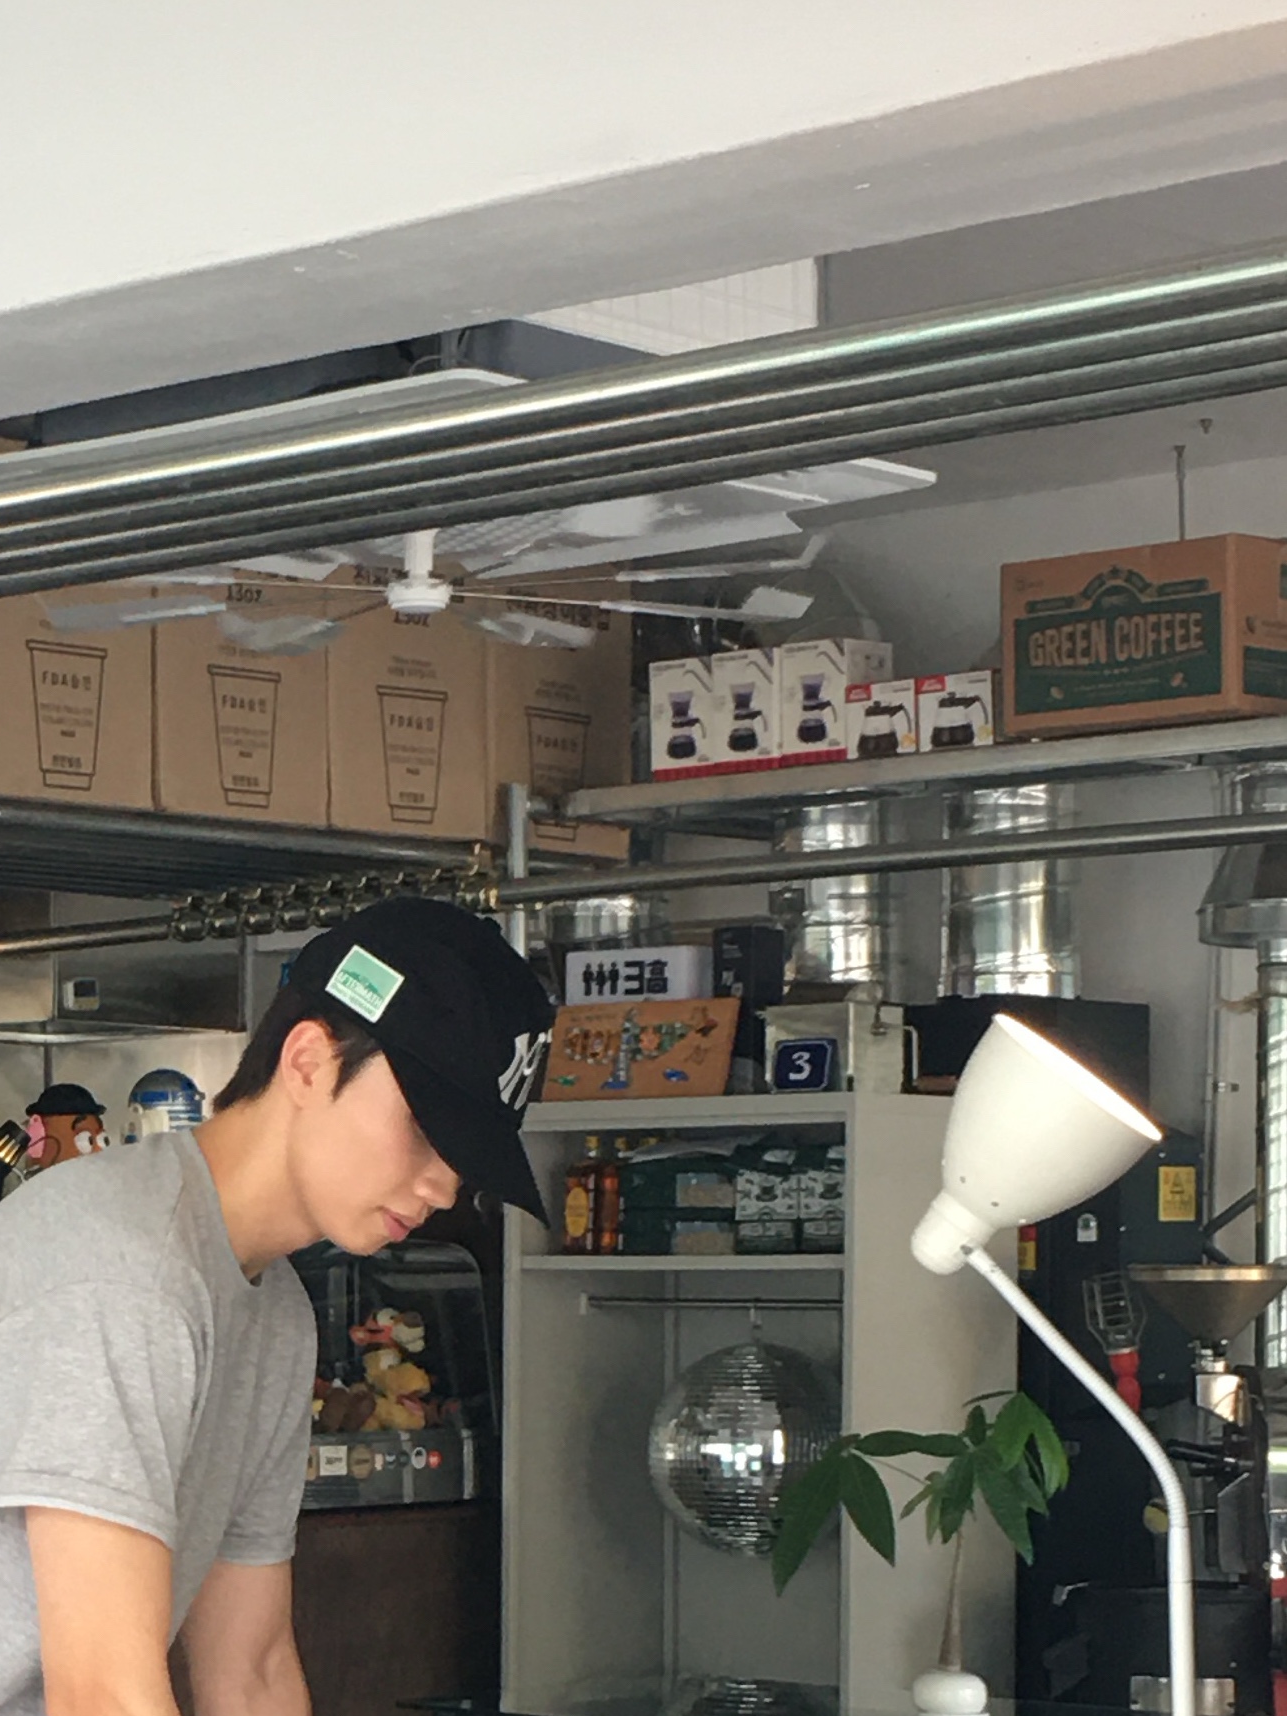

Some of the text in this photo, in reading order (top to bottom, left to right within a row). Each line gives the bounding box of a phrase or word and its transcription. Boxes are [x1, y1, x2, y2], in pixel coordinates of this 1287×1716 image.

[1028, 612, 1204, 667] GREEN COFFEE
[789, 1051, 812, 1081] 3
